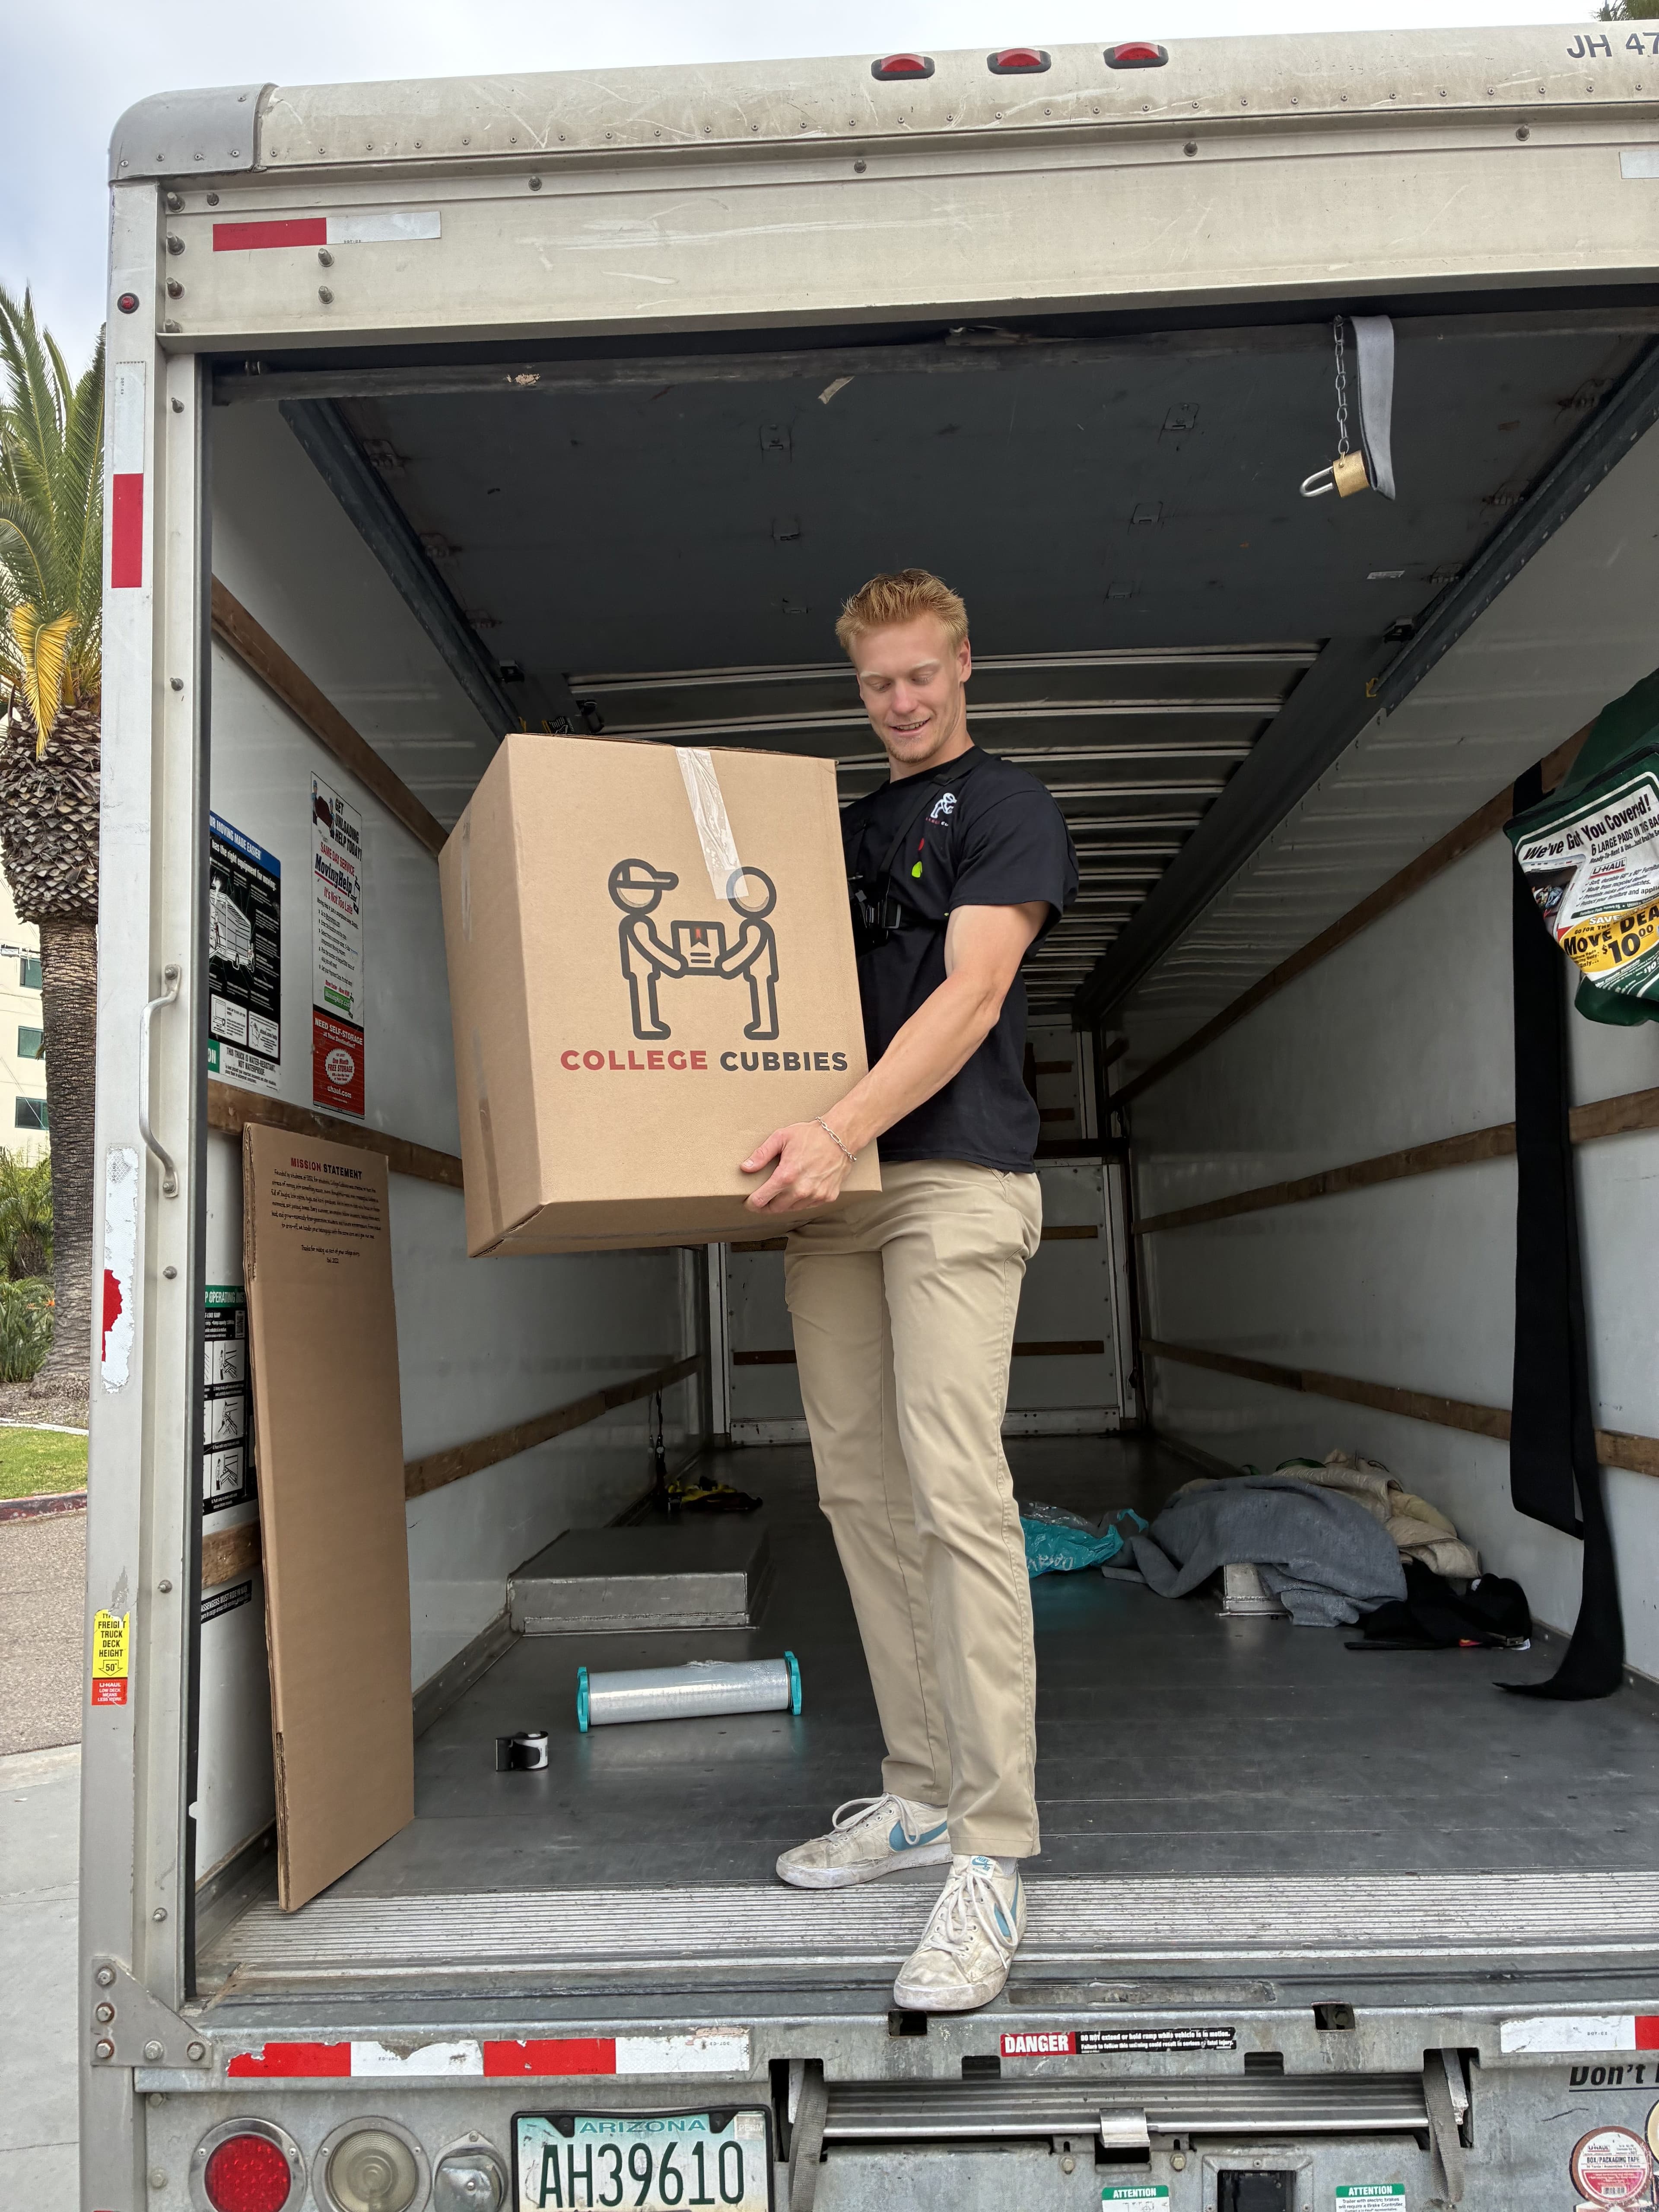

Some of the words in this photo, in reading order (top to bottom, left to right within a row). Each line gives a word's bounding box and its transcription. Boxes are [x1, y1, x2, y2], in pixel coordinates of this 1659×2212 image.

[1567, 34, 1612, 58] JH
[335, 798, 344, 815] GET
[216, 820, 234, 842] MOVING
[234, 833, 246, 850] MADE
[335, 813, 359, 844] UNLOADING
[335, 829, 346, 848] HELP
[347, 838, 362, 862] TODAY!
[1523, 840, 1564, 861] We've
[1580, 819, 1607, 841] You
[1591, 843, 1597, 856] 6
[1598, 834, 1618, 854] LARGE
[1618, 829, 1633, 845] PADS
[1633, 825, 1640, 837] IN
[227, 850, 237, 864] right
[321, 842, 332, 859] SAME
[340, 856, 355, 877] SERVICE
[1592, 859, 1626, 874] U-HAUL
[1589, 914, 1621, 925] SAVE
[1564, 928, 1612, 956] MOVE
[315, 1017, 328, 1030] NEED
[329, 1024, 363, 1045] SELF-STORAGE
[327, 1064, 337, 1073] FREE
[337, 1065, 353, 1073] STORAGE
[560, 1050, 708, 1070] COLLEGE
[720, 1052, 848, 1071] CUBBIES
[291, 1157, 321, 1172] MISSION
[323, 1163, 362, 1180] STATEMENT
[209, 1291, 235, 1303] OPERATING
[103, 1640, 120, 1648] DECK
[1004, 2034, 1069, 2053] DANGER
[1089, 2033, 1100, 2041] NOT
[1570, 2064, 1646, 2086] Don't
[579, 2120, 706, 2133] ARIZONA
[539, 2140, 744, 2209] AH39610
[1113, 2188, 1157, 2199] ATTENTION
[1348, 2186, 1393, 2196] ATTENTION
